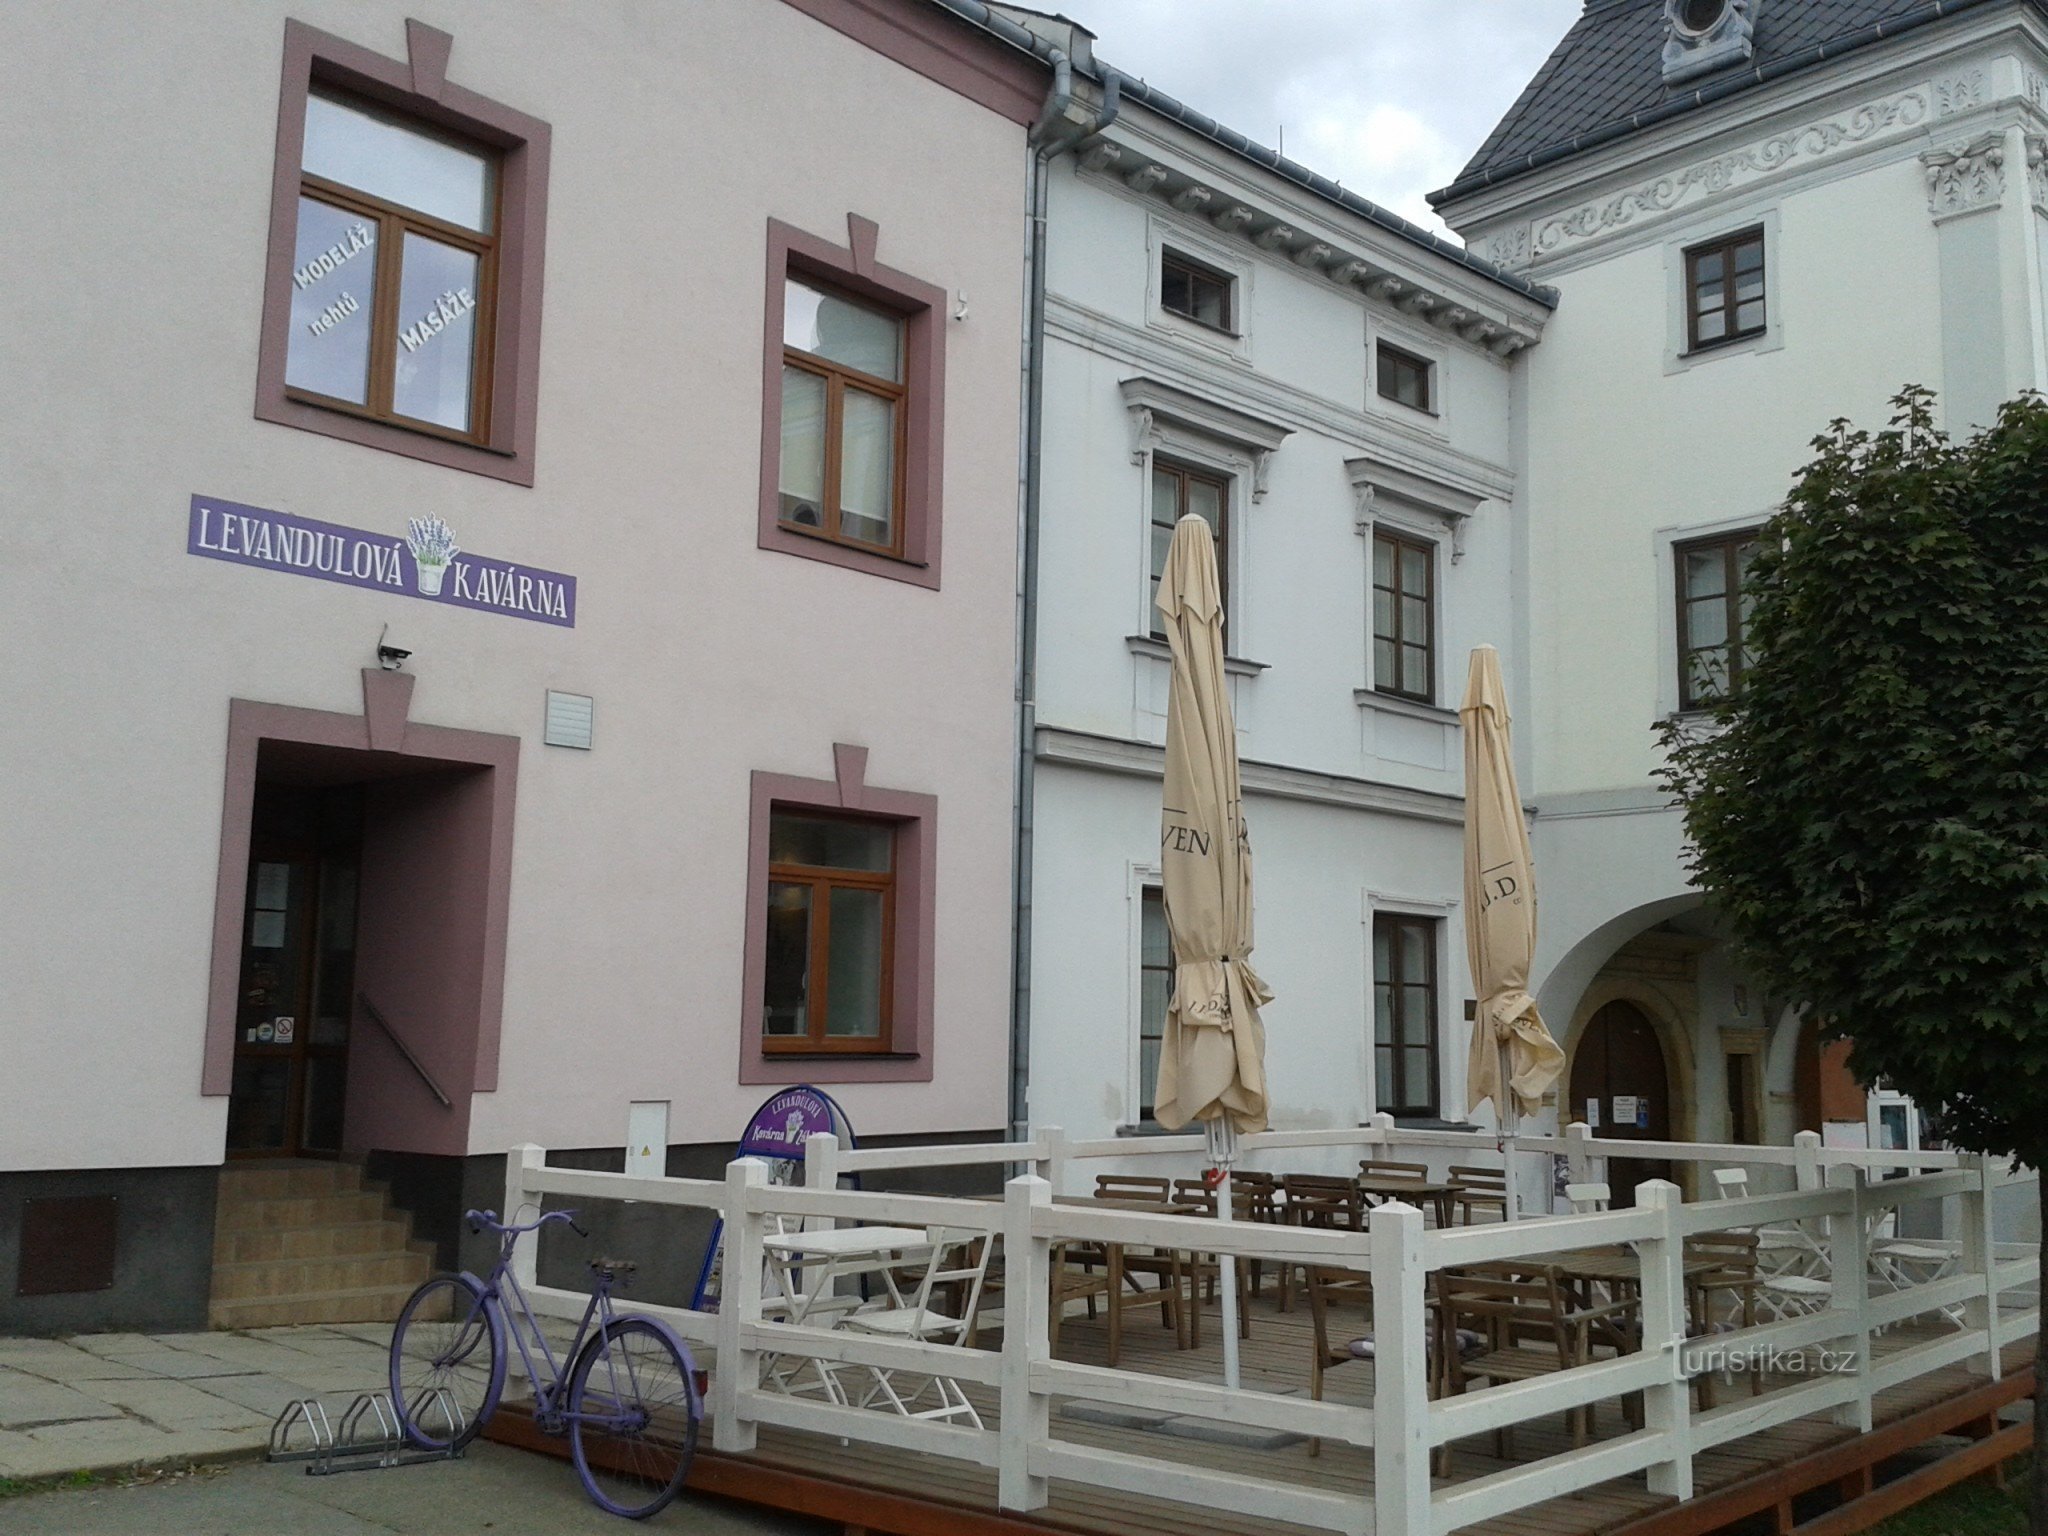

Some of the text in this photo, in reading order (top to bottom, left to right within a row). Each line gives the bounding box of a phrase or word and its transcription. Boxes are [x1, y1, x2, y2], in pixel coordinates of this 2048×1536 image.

[293, 222, 375, 291] MODELÁŽ
[308, 292, 360, 337] nehtů
[399, 288, 476, 354] MASÁŽE
[197, 508, 569, 619] LEVANDULOVÁ KAVÁRNA
[752, 1125, 784, 1141] Kavárna
[772, 1095, 822, 1118] LEVANDULOVÁ
